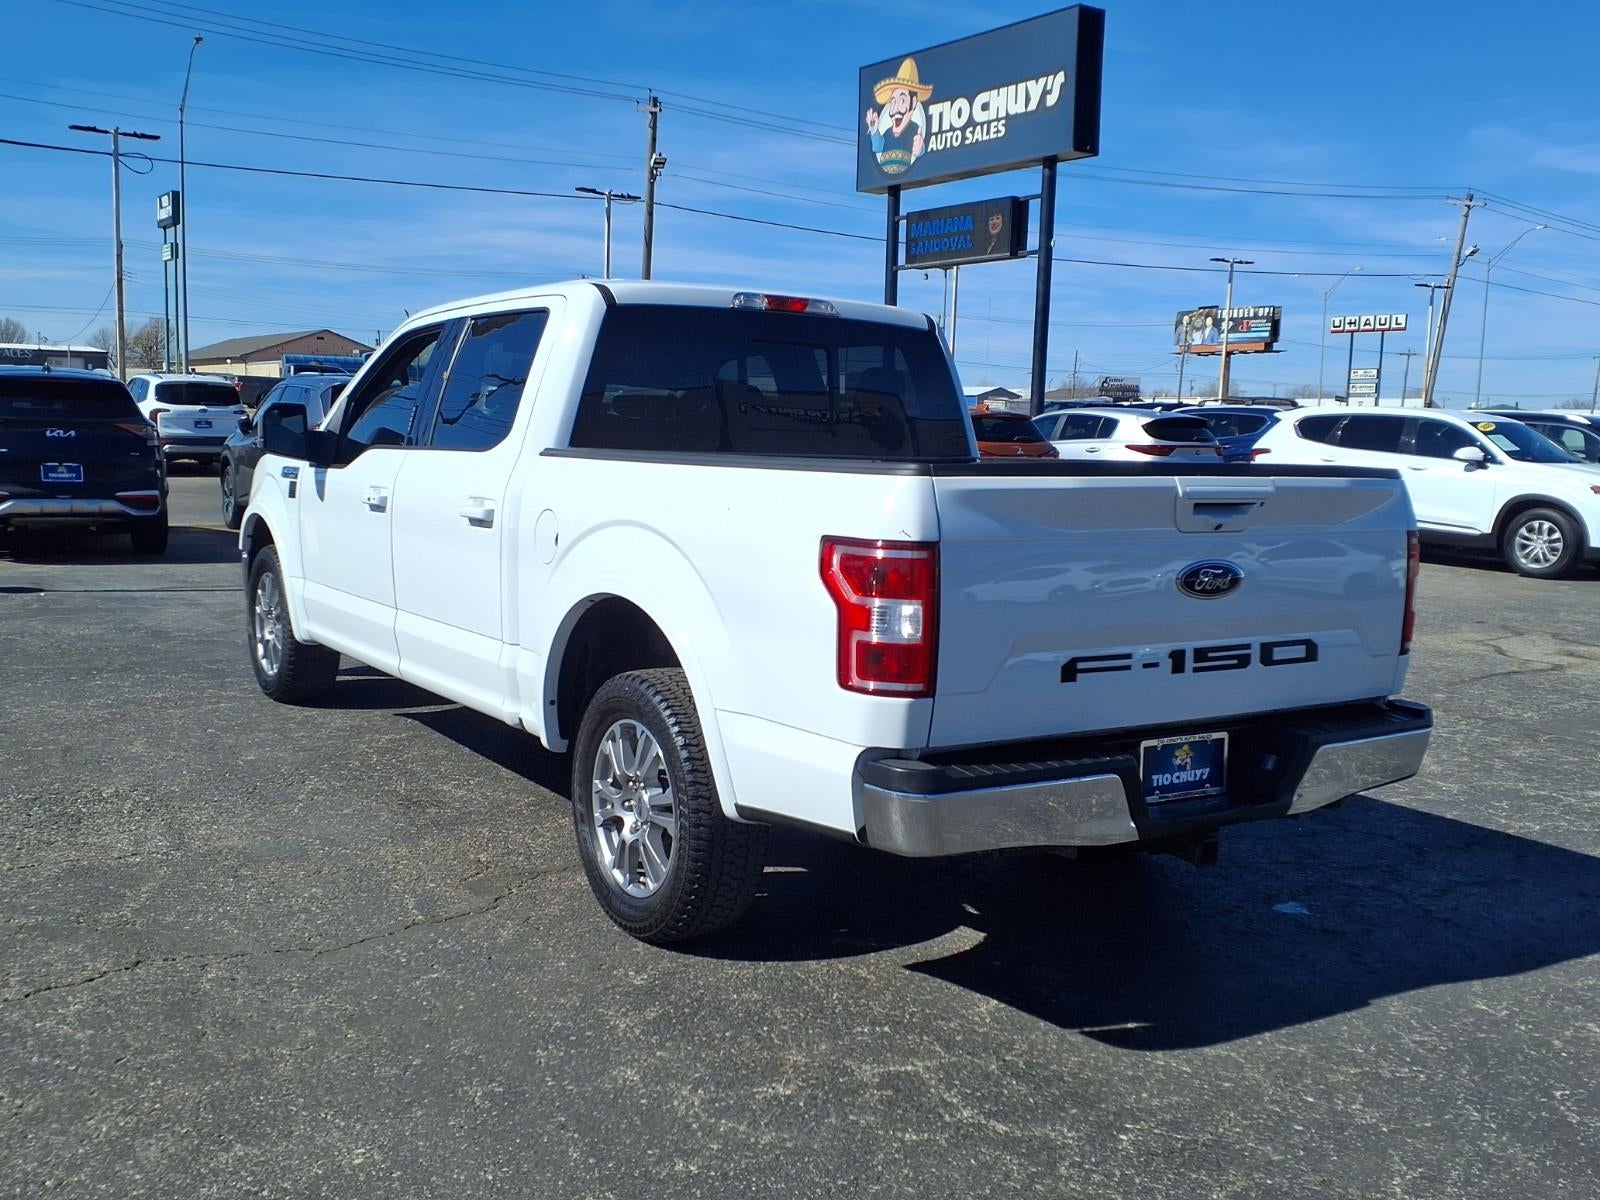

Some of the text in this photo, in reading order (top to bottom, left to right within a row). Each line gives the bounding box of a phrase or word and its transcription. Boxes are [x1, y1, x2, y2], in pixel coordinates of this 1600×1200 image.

[928, 70, 1066, 134] TIO CHUY'S
[927, 119, 1007, 152] AUTO SALES
[911, 215, 974, 238] MARIANA
[910, 235, 974, 256] SANDOVAL
[1194, 568, 1232, 590] Ford
[1060, 638, 1319, 683] F-150
[1151, 767, 1211, 787] TIO CHUY'S
